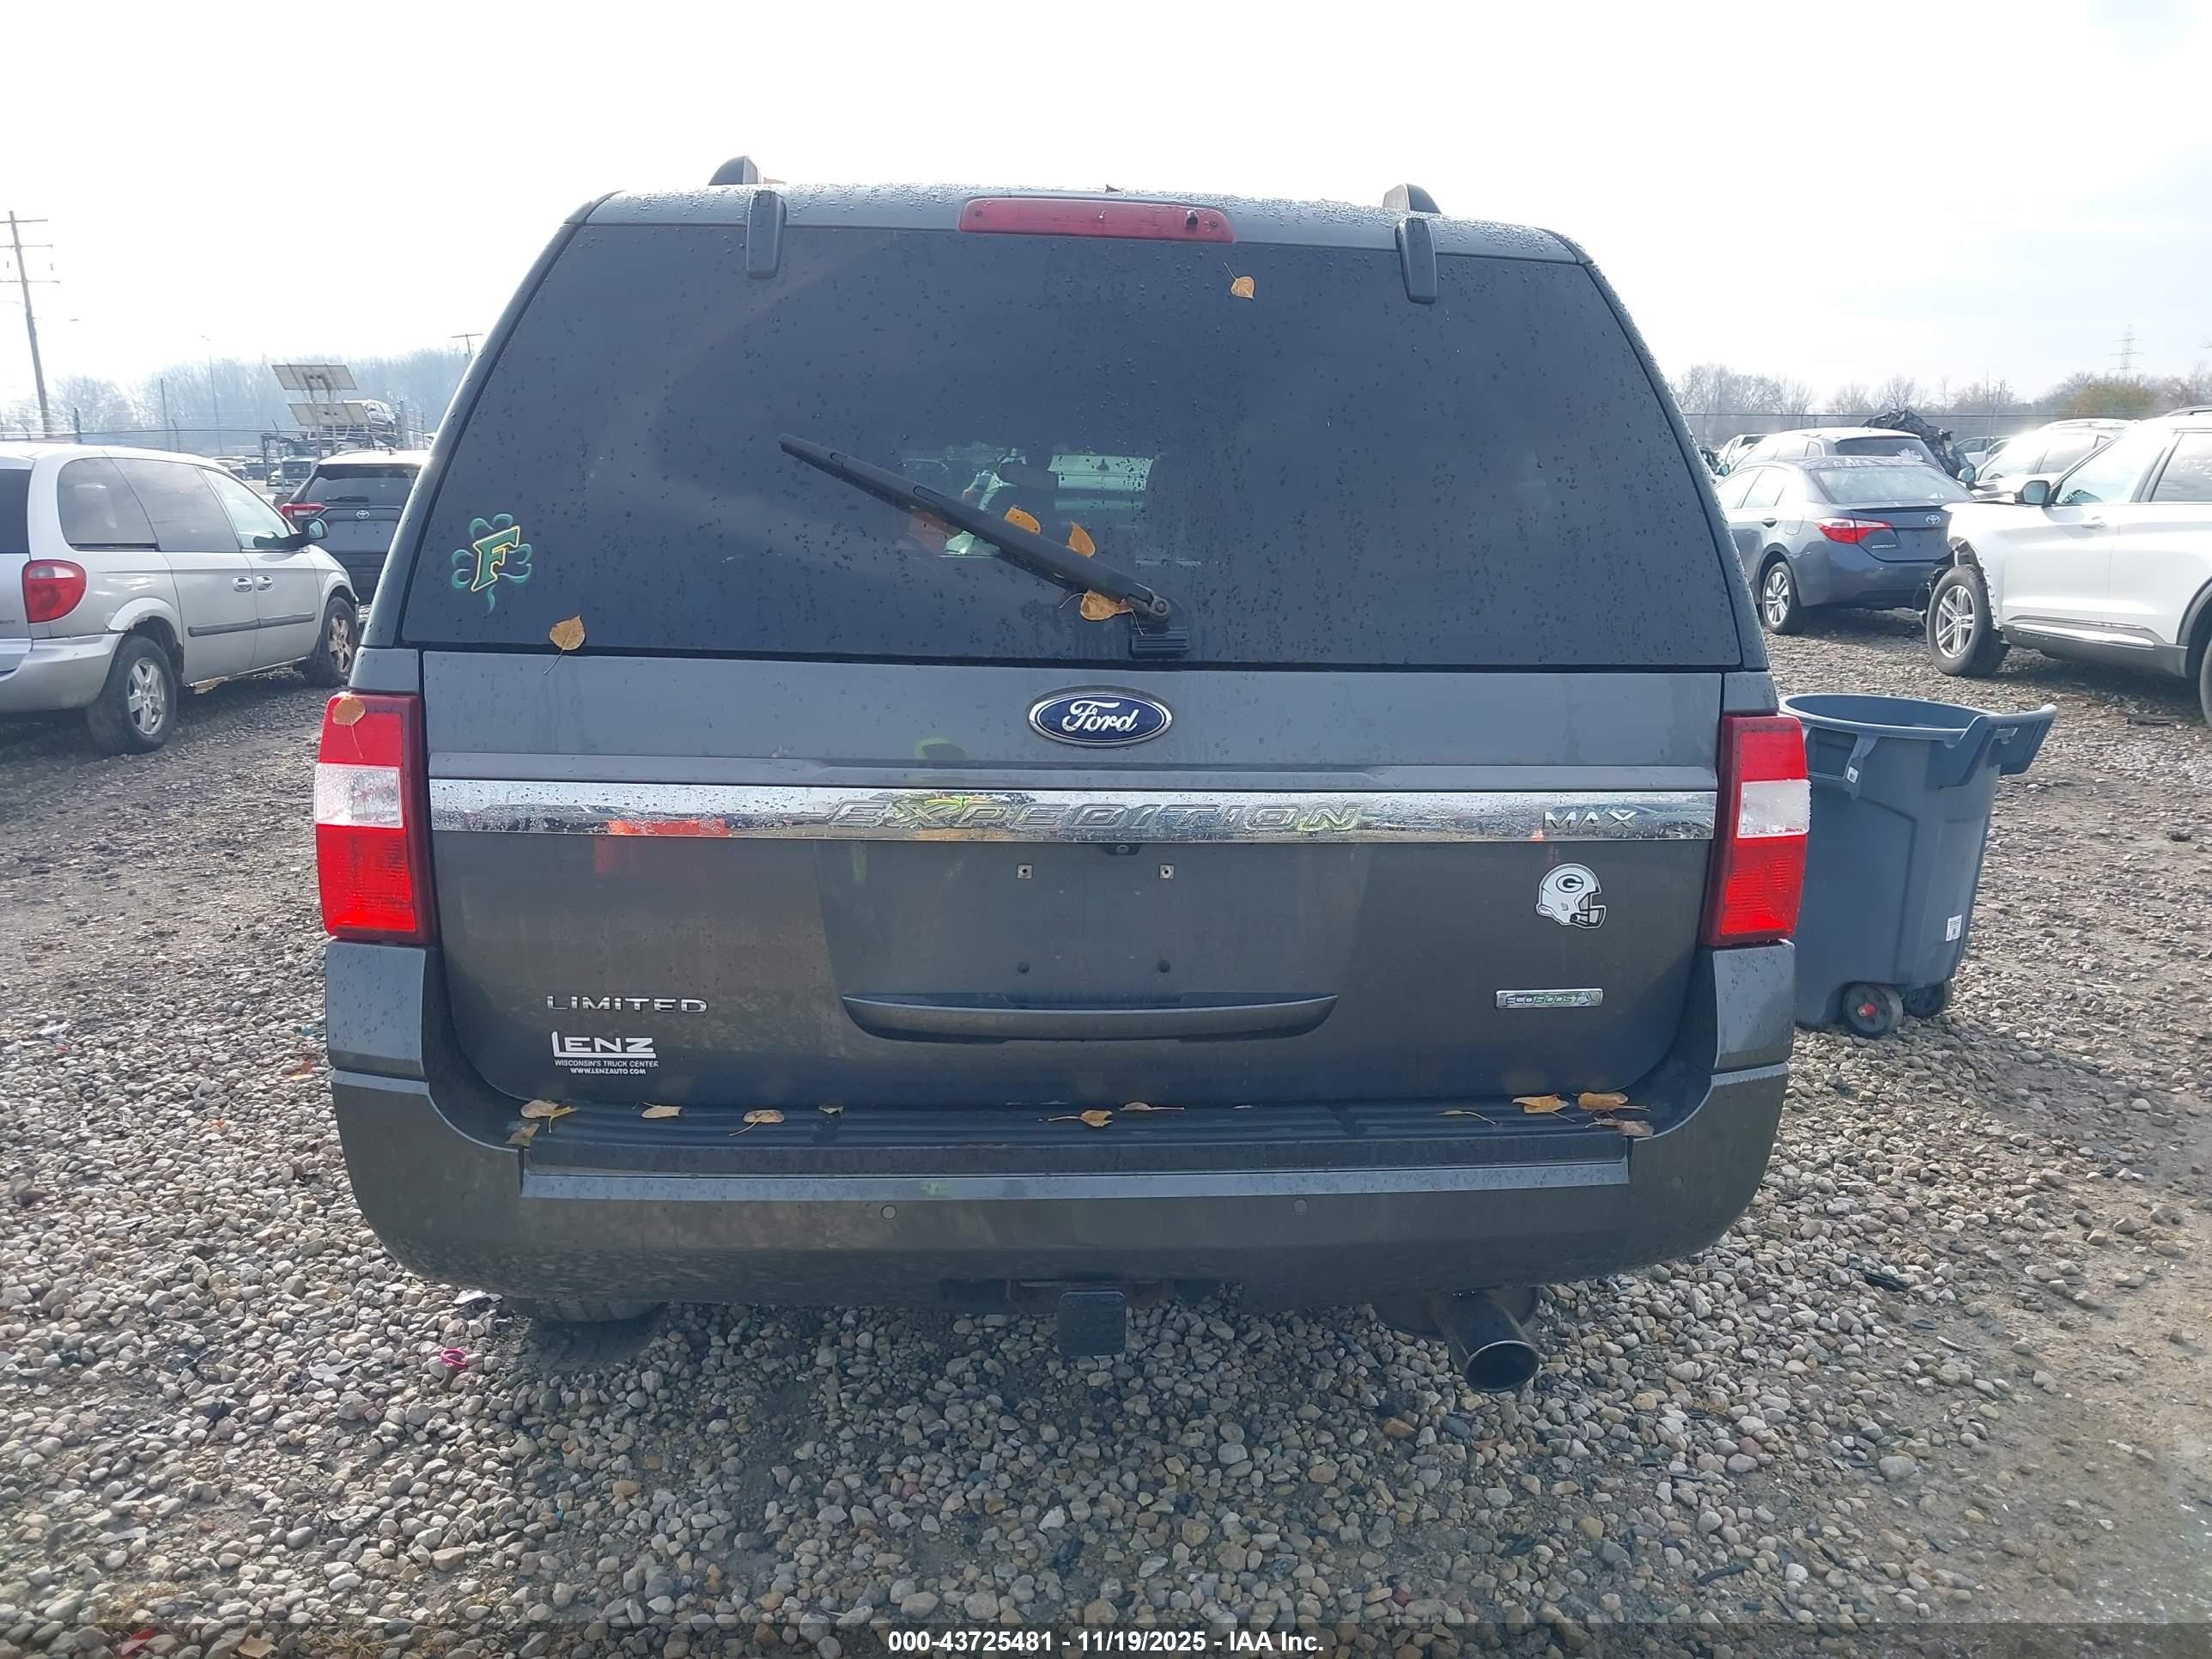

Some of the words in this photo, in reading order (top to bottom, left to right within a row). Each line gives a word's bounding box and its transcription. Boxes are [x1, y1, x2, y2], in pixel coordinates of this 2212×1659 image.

[471, 525, 520, 592] F
[1061, 700, 1139, 732] Ford
[828, 801, 1362, 832] EXPEDITION
[1542, 811, 1638, 830] MAX
[546, 995, 708, 1012] LIMITED
[1505, 995, 1581, 1005] ECOBOOST
[551, 1030, 657, 1058] LENZ
[554, 1059, 601, 1067] WISCONSIN'S
[629, 1060, 659, 1068] CENTER
[569, 1066, 647, 1075] WWW.LENZAUTOCOM
